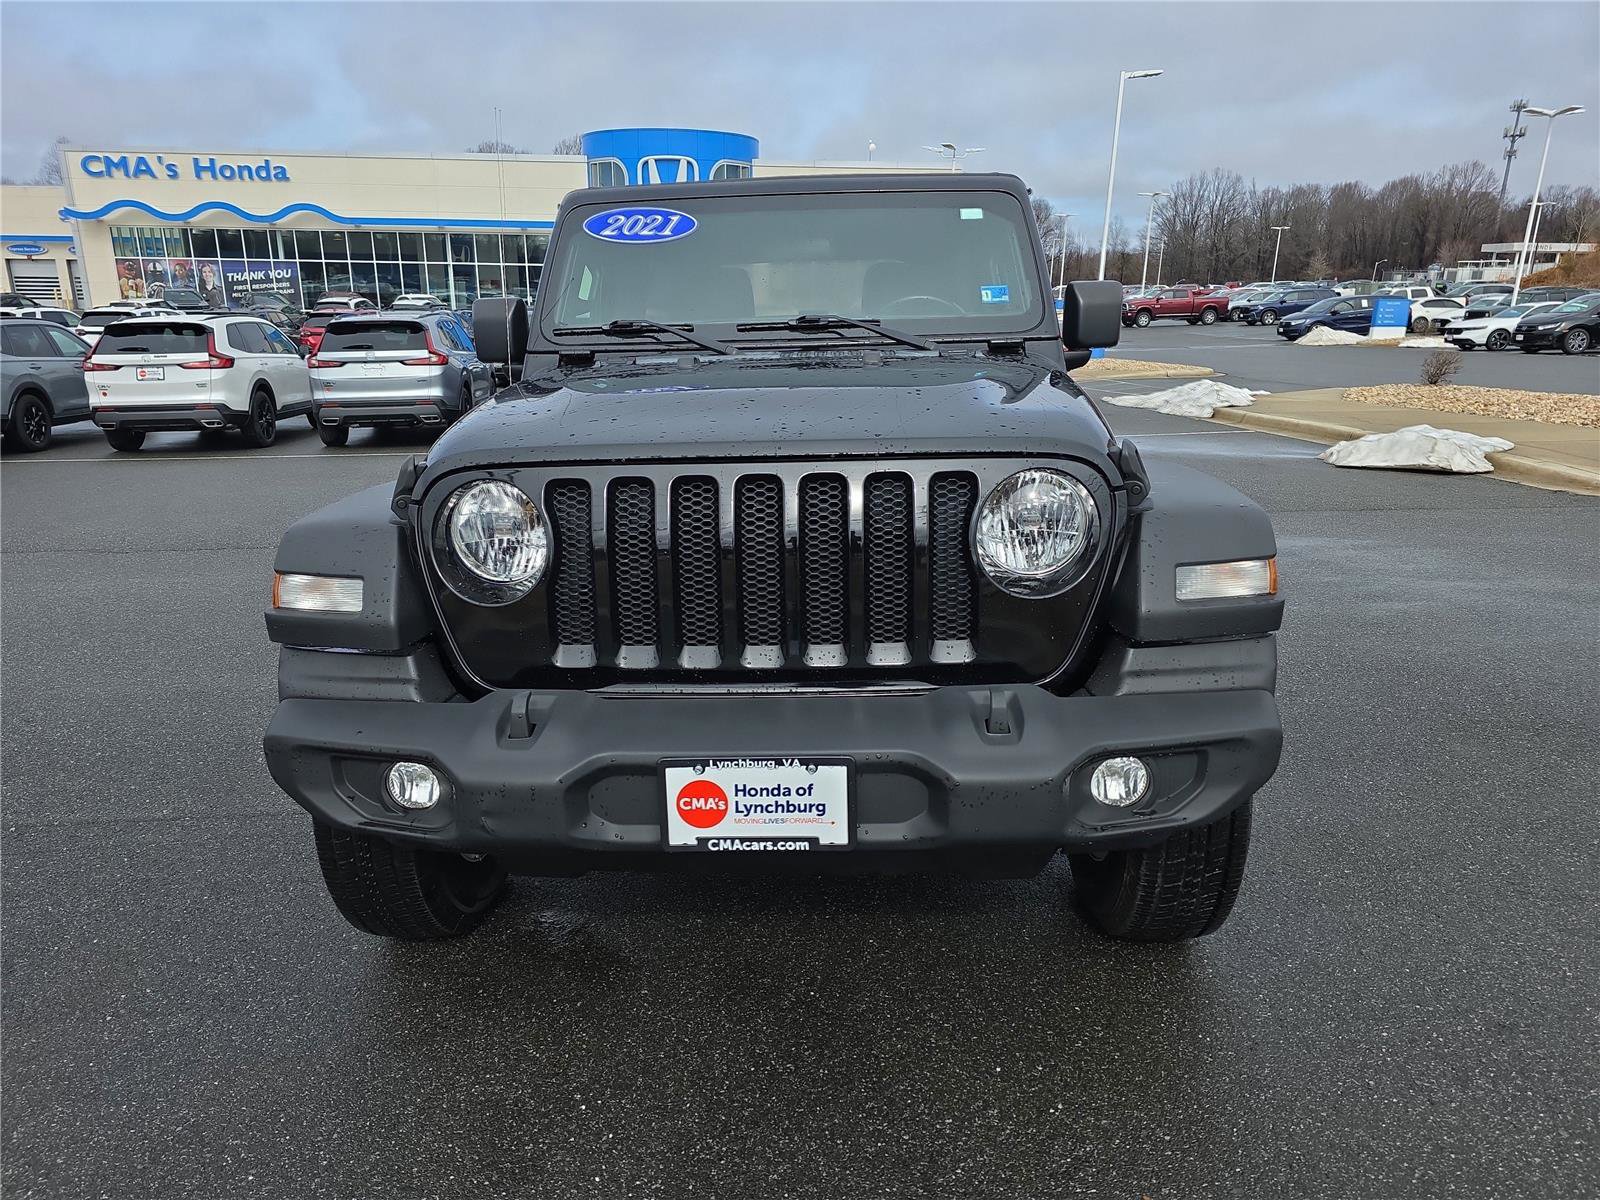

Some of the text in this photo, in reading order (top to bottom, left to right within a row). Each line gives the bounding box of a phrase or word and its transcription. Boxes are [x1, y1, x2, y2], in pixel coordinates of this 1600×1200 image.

[80, 154, 290, 182] CMA's Honda
[600, 214, 681, 236] 2021
[227, 268, 291, 281] THANK YOU
[252, 282, 290, 290] RESPONDERS
[709, 759, 801, 770] Lynchburg, VA
[734, 783, 814, 797] Honda of
[679, 797, 726, 811] CMA's
[734, 800, 826, 816] Lynchburg
[707, 839, 810, 851] CMAcars.com
